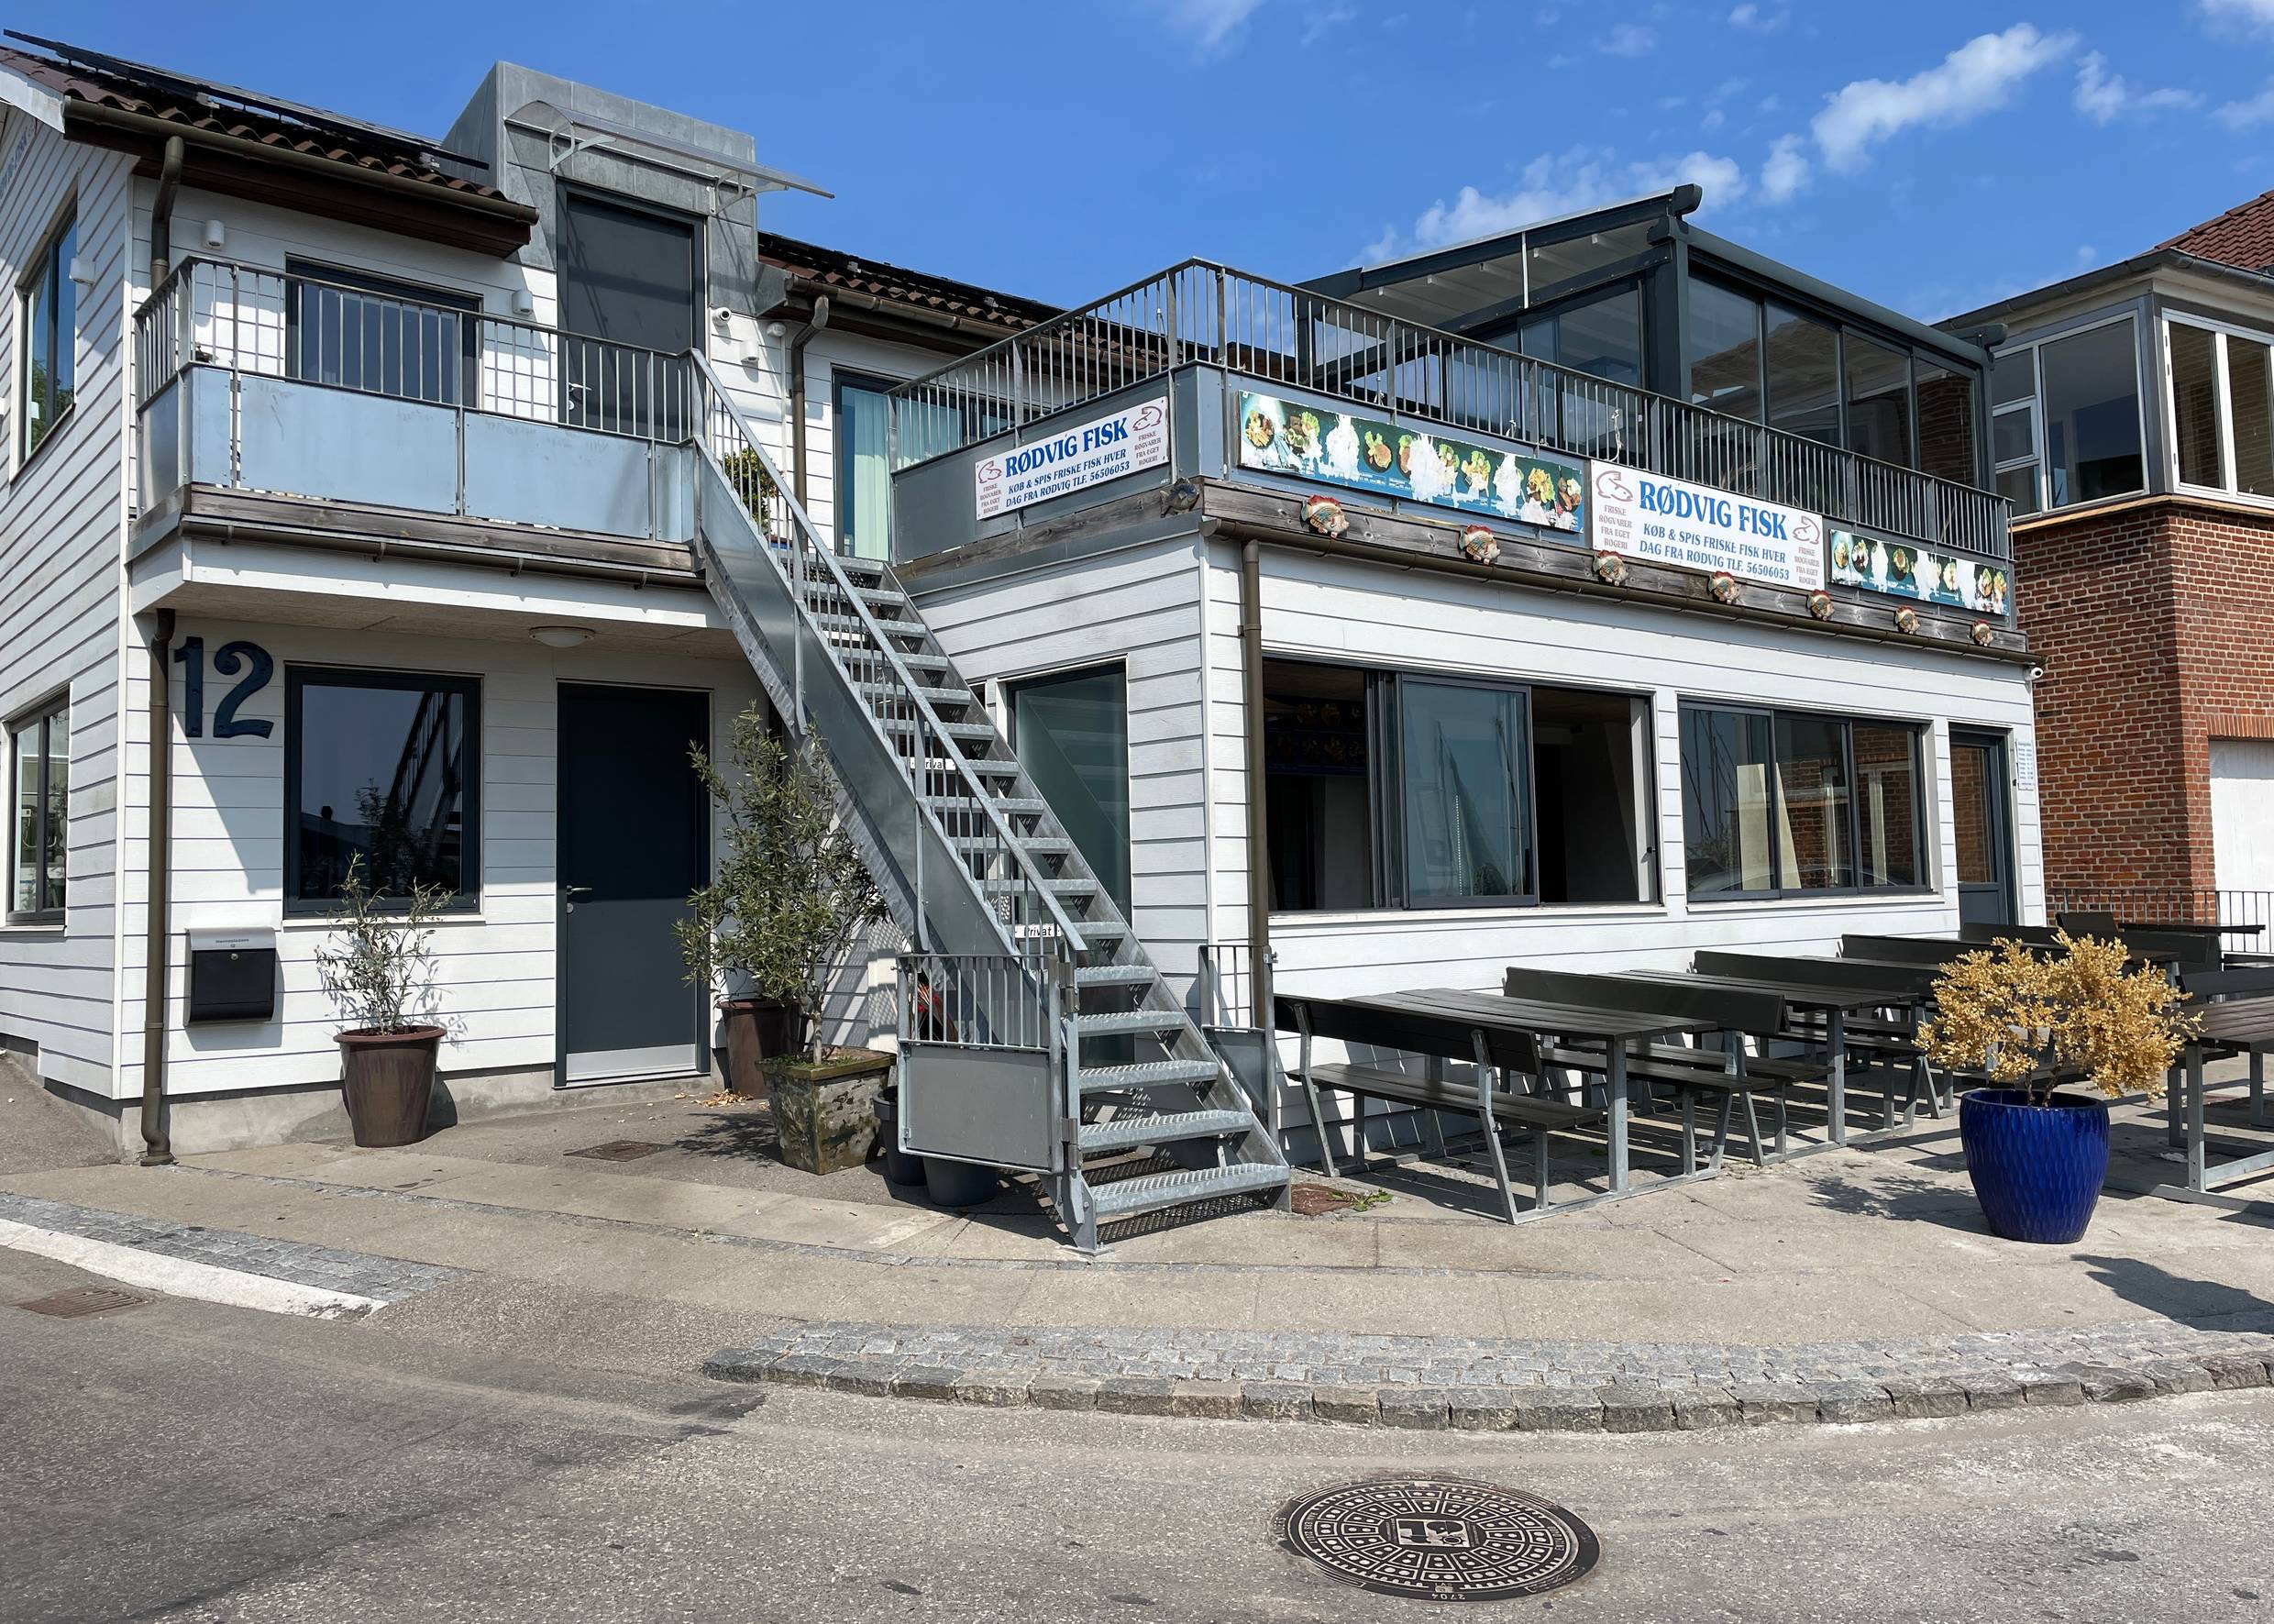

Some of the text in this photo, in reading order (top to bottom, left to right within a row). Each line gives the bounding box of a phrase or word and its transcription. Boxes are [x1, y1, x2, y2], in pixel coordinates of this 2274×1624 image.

[1005, 417, 1128, 478] RØDVIG FISK
[1138, 431, 1157, 441] FRISKE
[1006, 497, 1022, 508] DAG
[1023, 492, 1038, 503] FRA
[1041, 480, 1071, 498] RØDVIG
[1089, 461, 1130, 481] 56506053
[1009, 448, 1127, 495] KØB & SPIS FRISKE FISK HVER
[1604, 504, 1627, 516] FRISKE
[1639, 480, 1788, 541] RØDVIG FISK
[1600, 525, 1630, 539] FRA EGET
[1643, 523, 1786, 563] KØB & SPIS FRISKE FISK HVER
[1639, 540, 1790, 580] DAG FRA RØDVIG TLF. 56506053
[173, 635, 274, 739] 12
